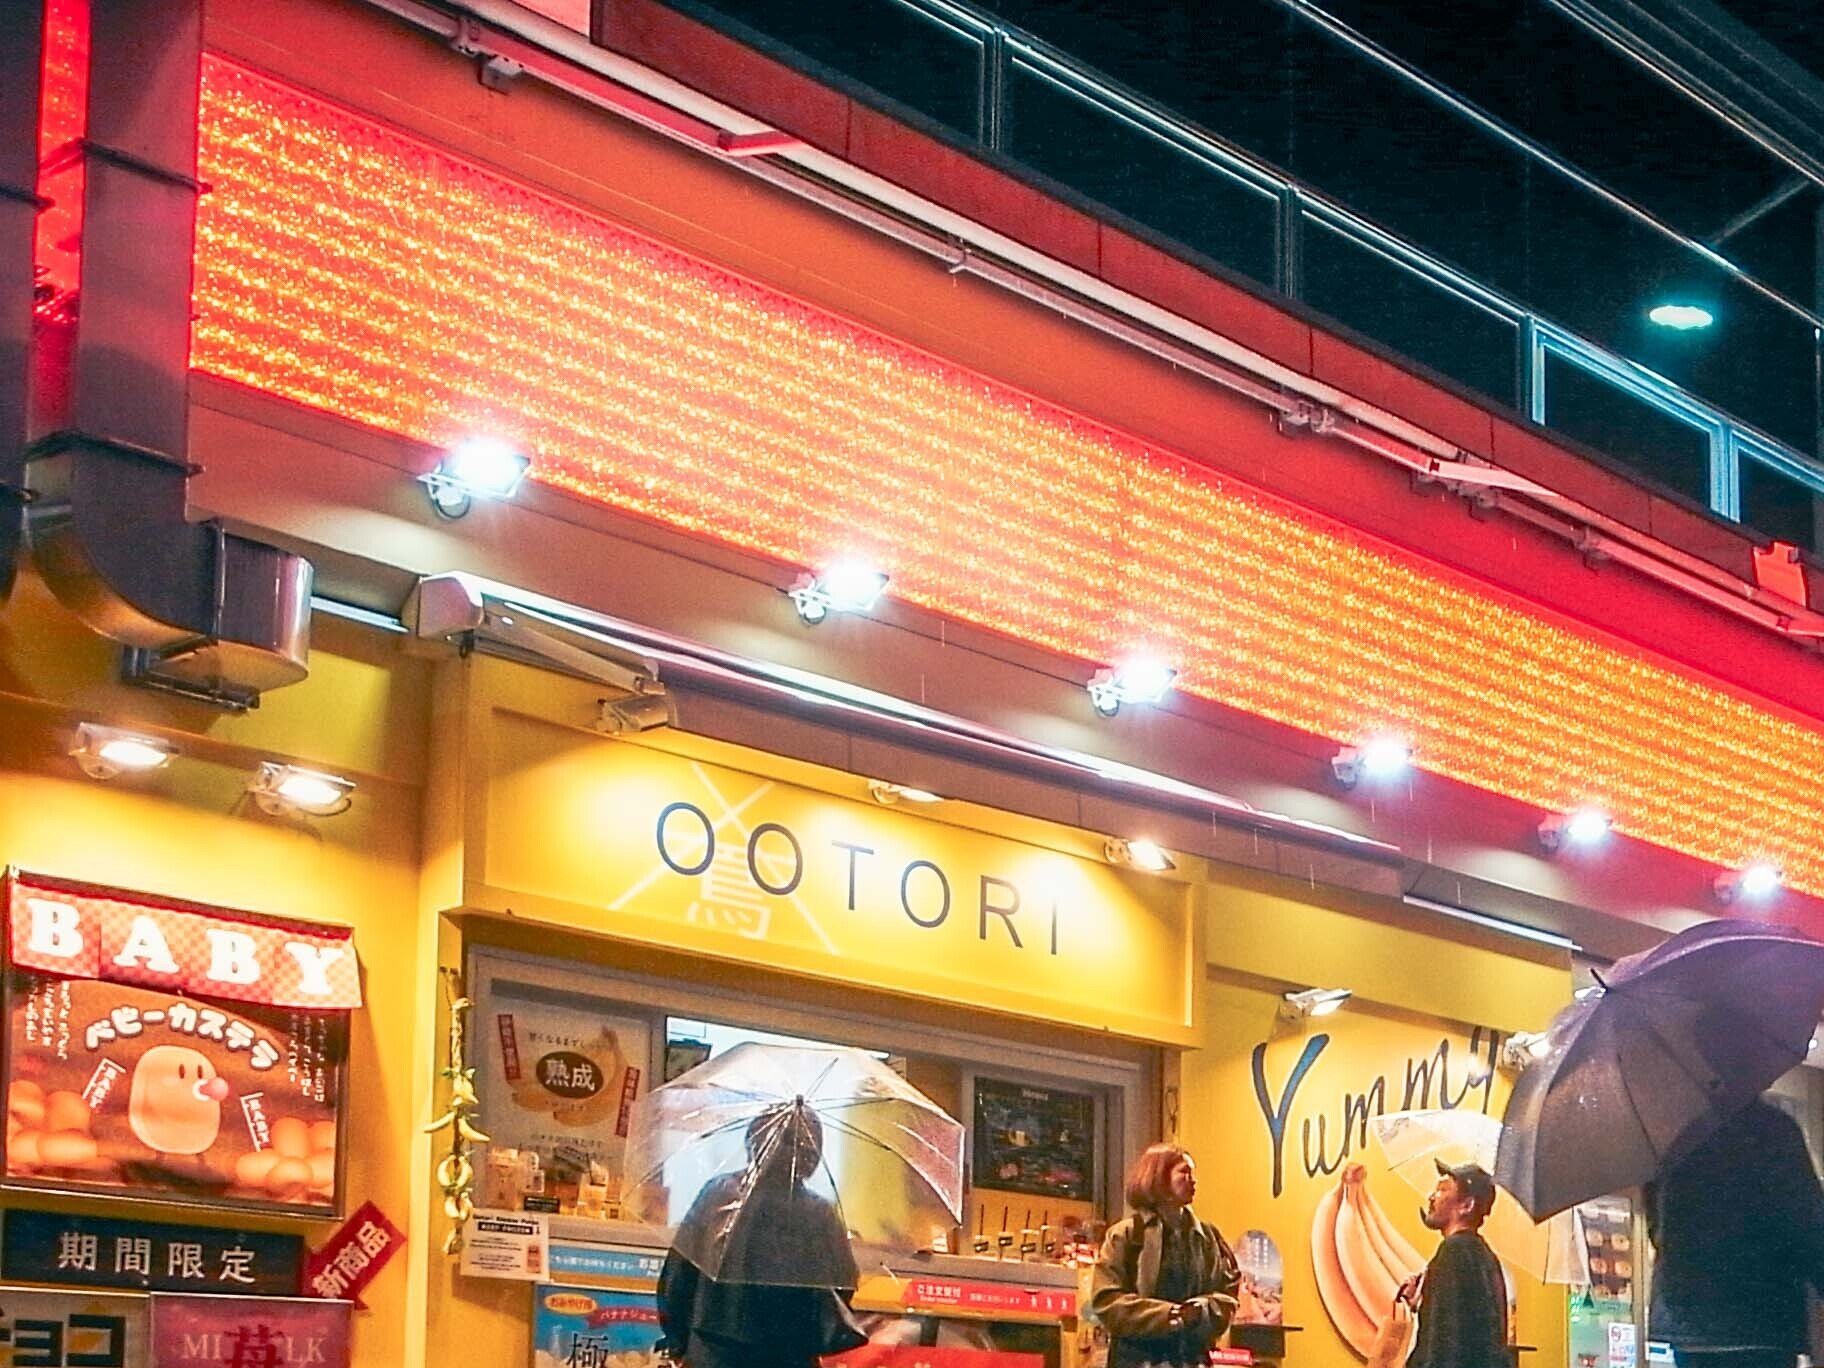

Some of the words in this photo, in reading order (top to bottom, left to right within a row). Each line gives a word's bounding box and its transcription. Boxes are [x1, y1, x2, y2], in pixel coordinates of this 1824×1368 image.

[656, 801, 1060, 955] OOTORI
[27, 898, 344, 994] BABY
[85, 1002, 279, 1069] ベビーカステラ
[1252, 1026, 1499, 1199] Yummy
[58, 1232, 256, 1284] 期間限定
[311, 1221, 392, 1299] 新商品
[0, 1307, 126, 1368] ョコ
